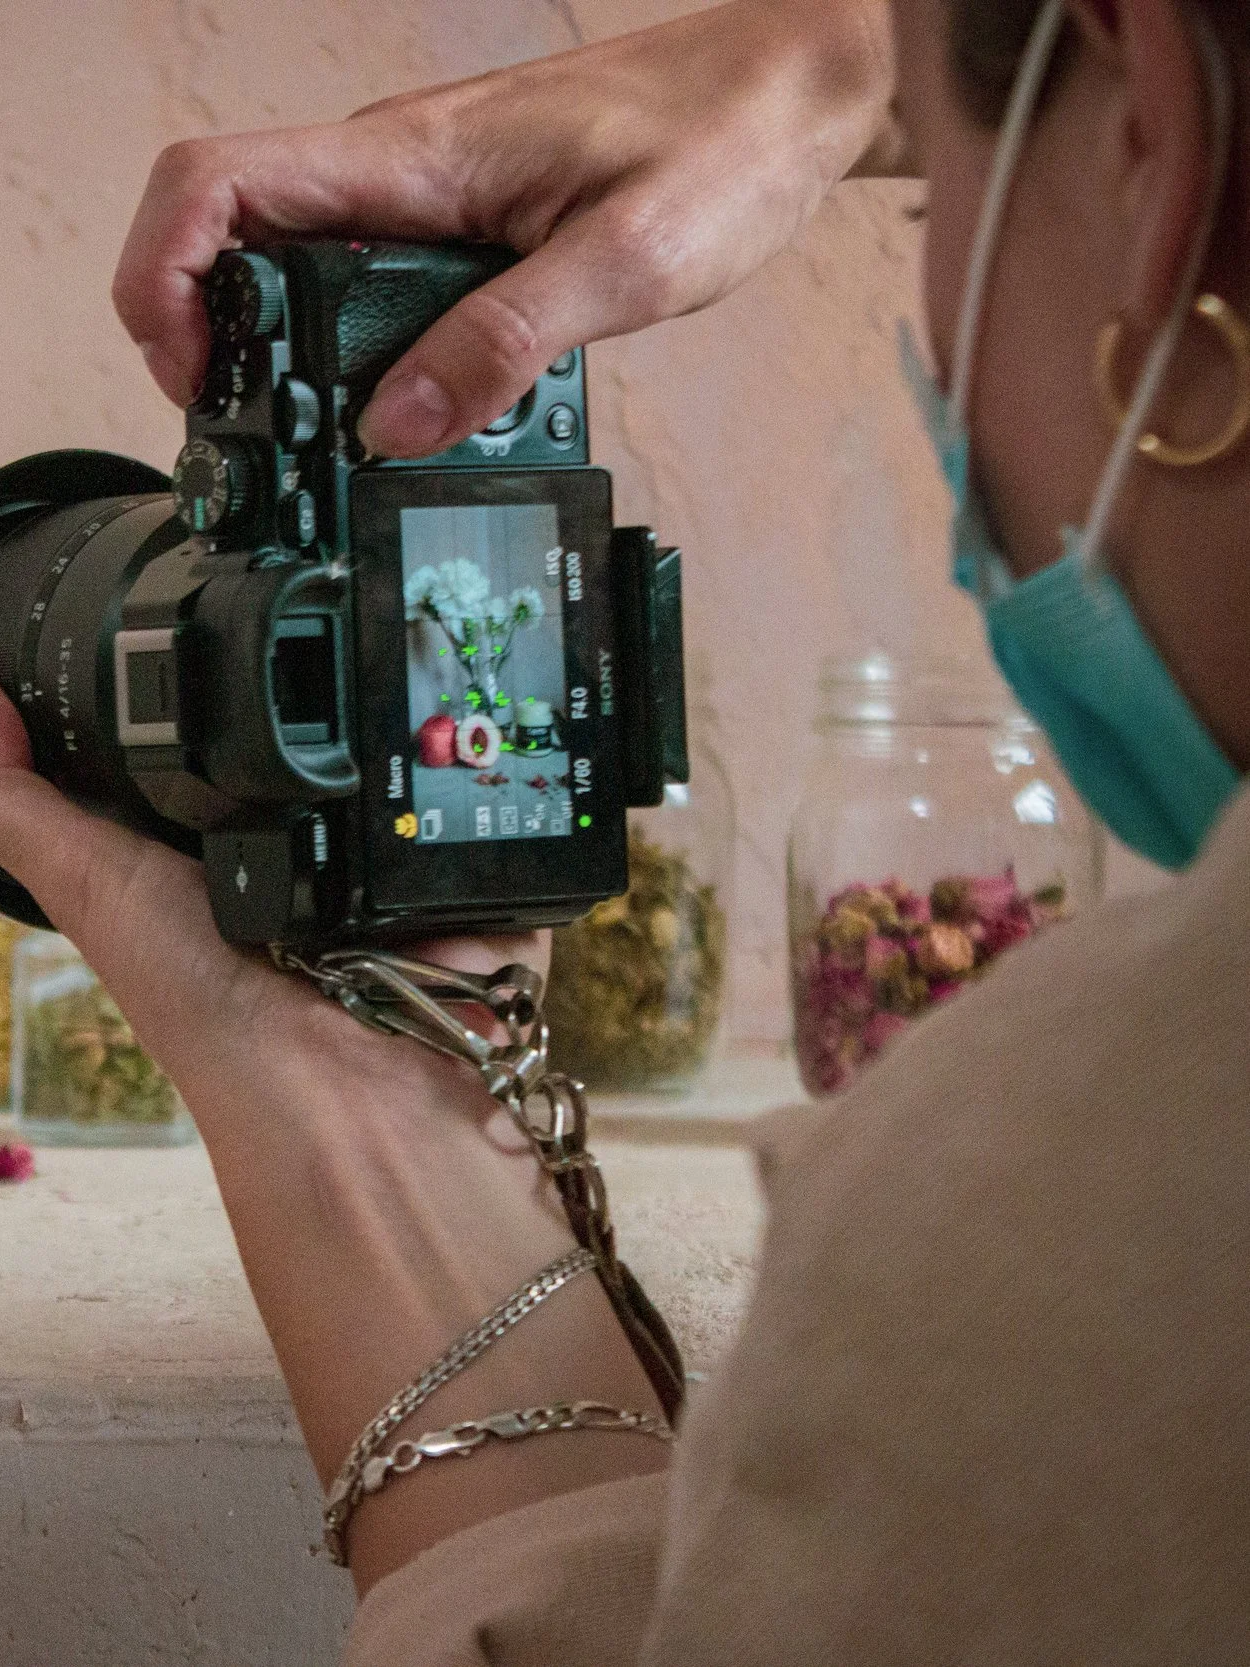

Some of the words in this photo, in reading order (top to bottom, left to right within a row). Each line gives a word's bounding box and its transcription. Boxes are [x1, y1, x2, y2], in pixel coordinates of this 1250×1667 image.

[230, 364, 245, 394] OFF
[21, 681, 34, 702] 35
[31, 601, 46, 622] 28
[50, 556, 69, 574] 24
[598, 648, 614, 716] SONY
[570, 686, 588, 720] F4.0
[63, 729, 78, 752] FE
[386, 754, 404, 800] Macro
[574, 757, 592, 795] 1/60
[313, 824, 328, 862] MENU
